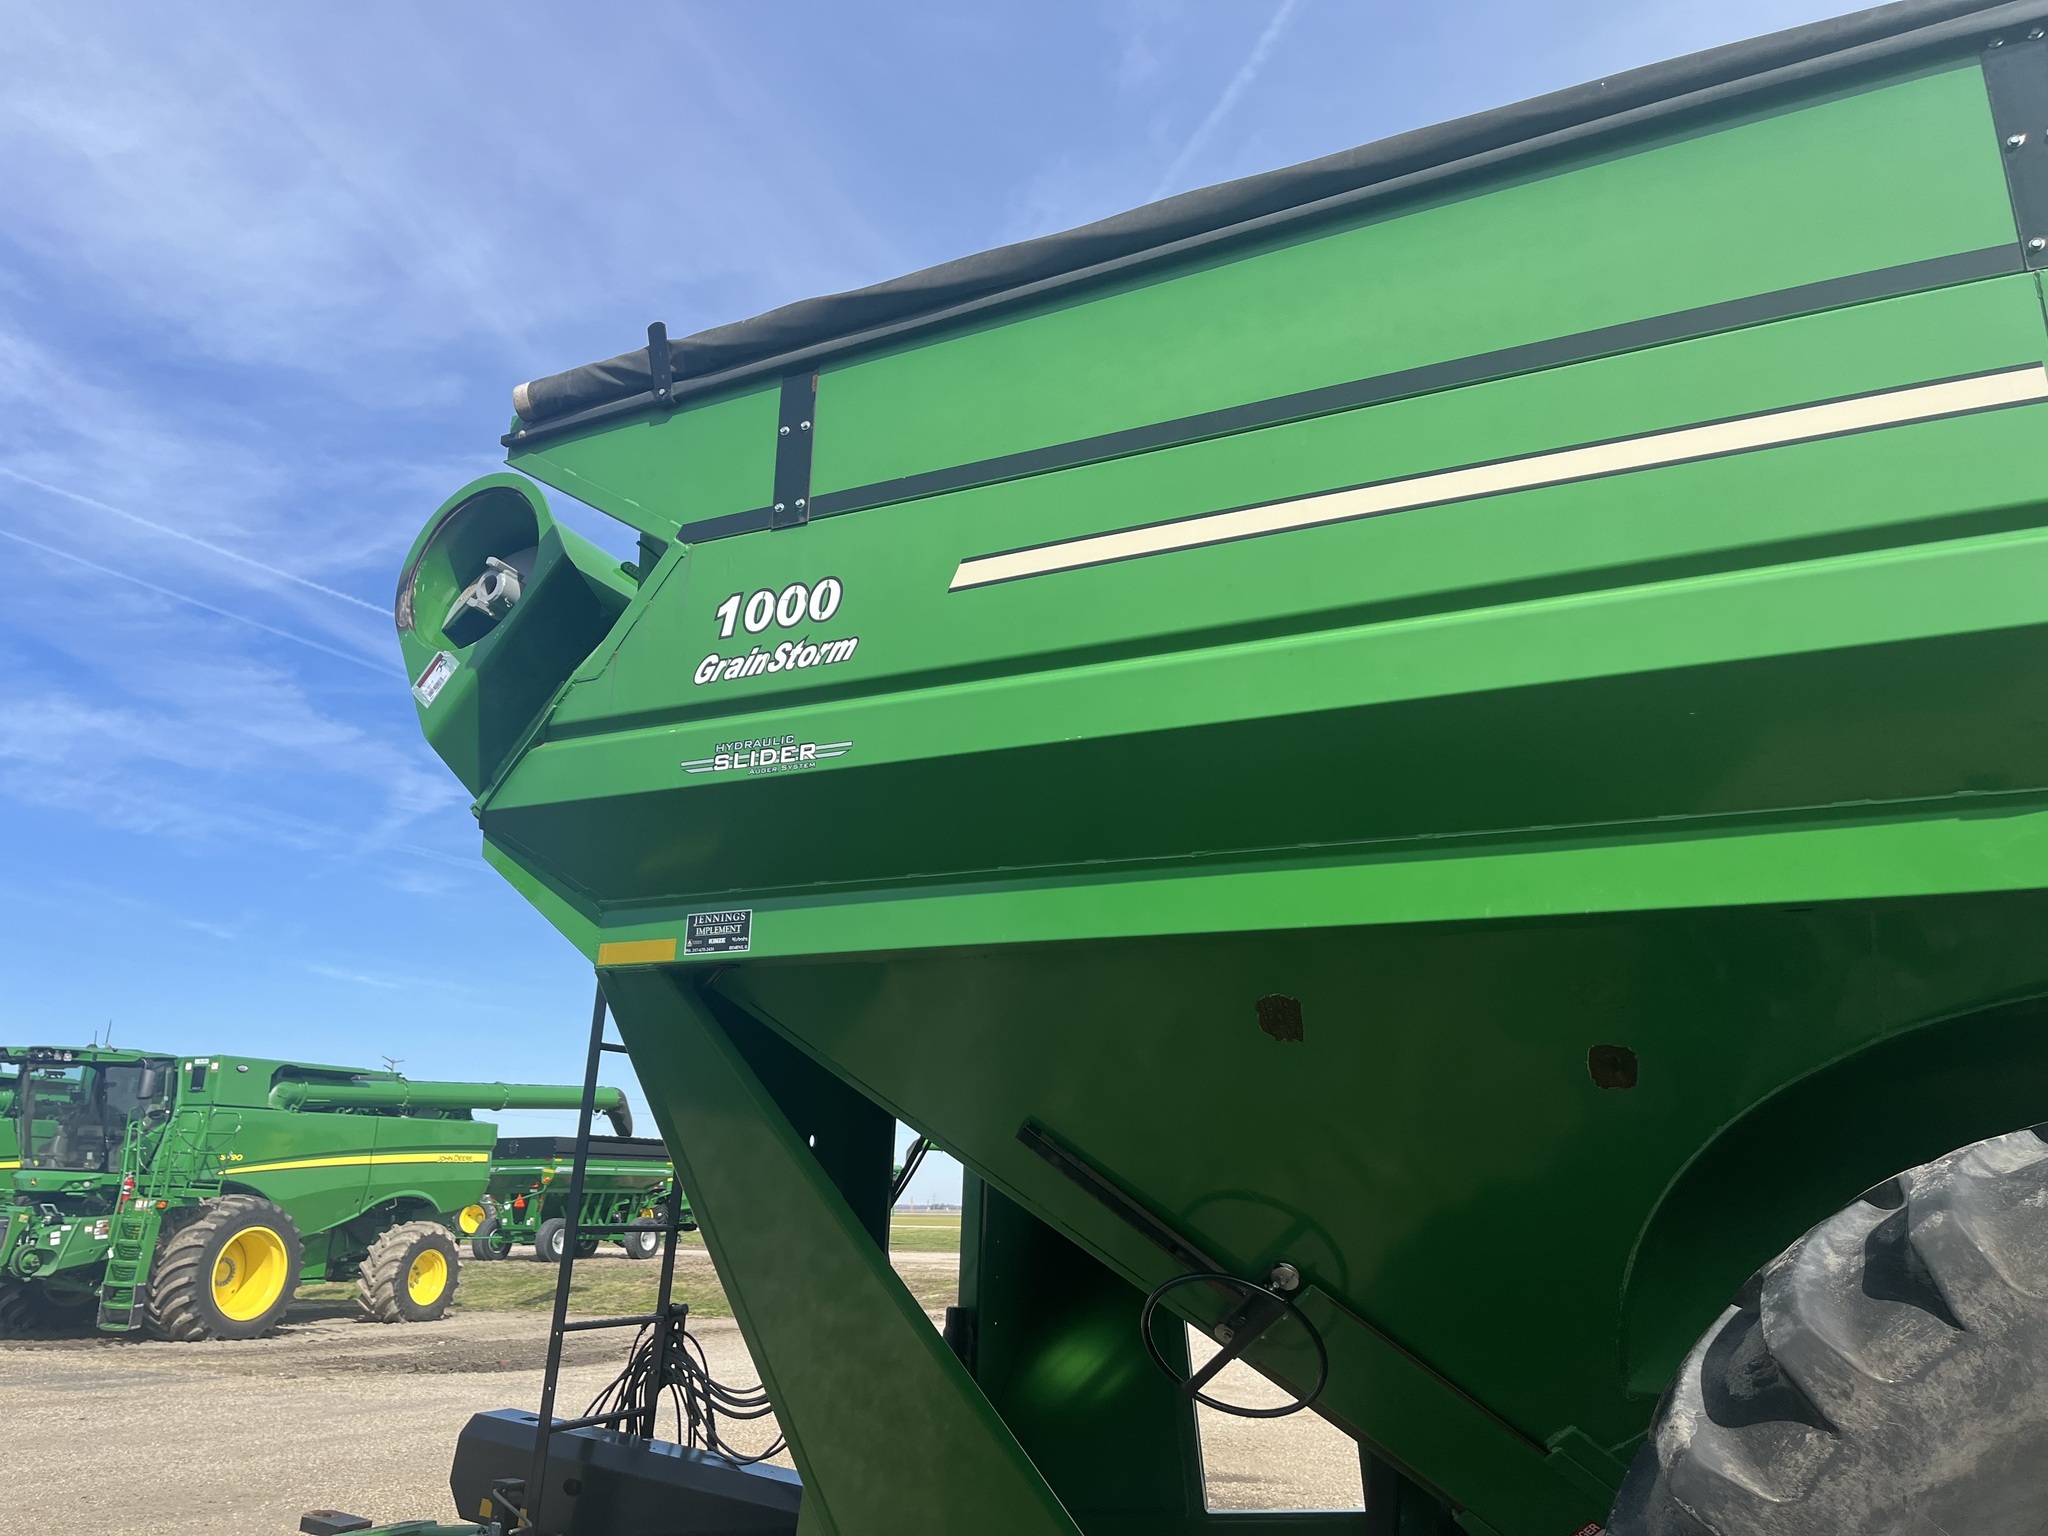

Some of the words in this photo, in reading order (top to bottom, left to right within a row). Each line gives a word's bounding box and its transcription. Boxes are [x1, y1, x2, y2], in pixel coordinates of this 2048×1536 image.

[714, 576, 844, 640] 1000
[693, 635, 860, 686] GrainStorm
[715, 734, 796, 753] HYDRAULIC
[713, 742, 818, 772] SLIDER
[781, 761, 816, 772] SYSTEM
[693, 912, 746, 927] JENNINGS
[696, 924, 742, 935] IMPLEMENT
